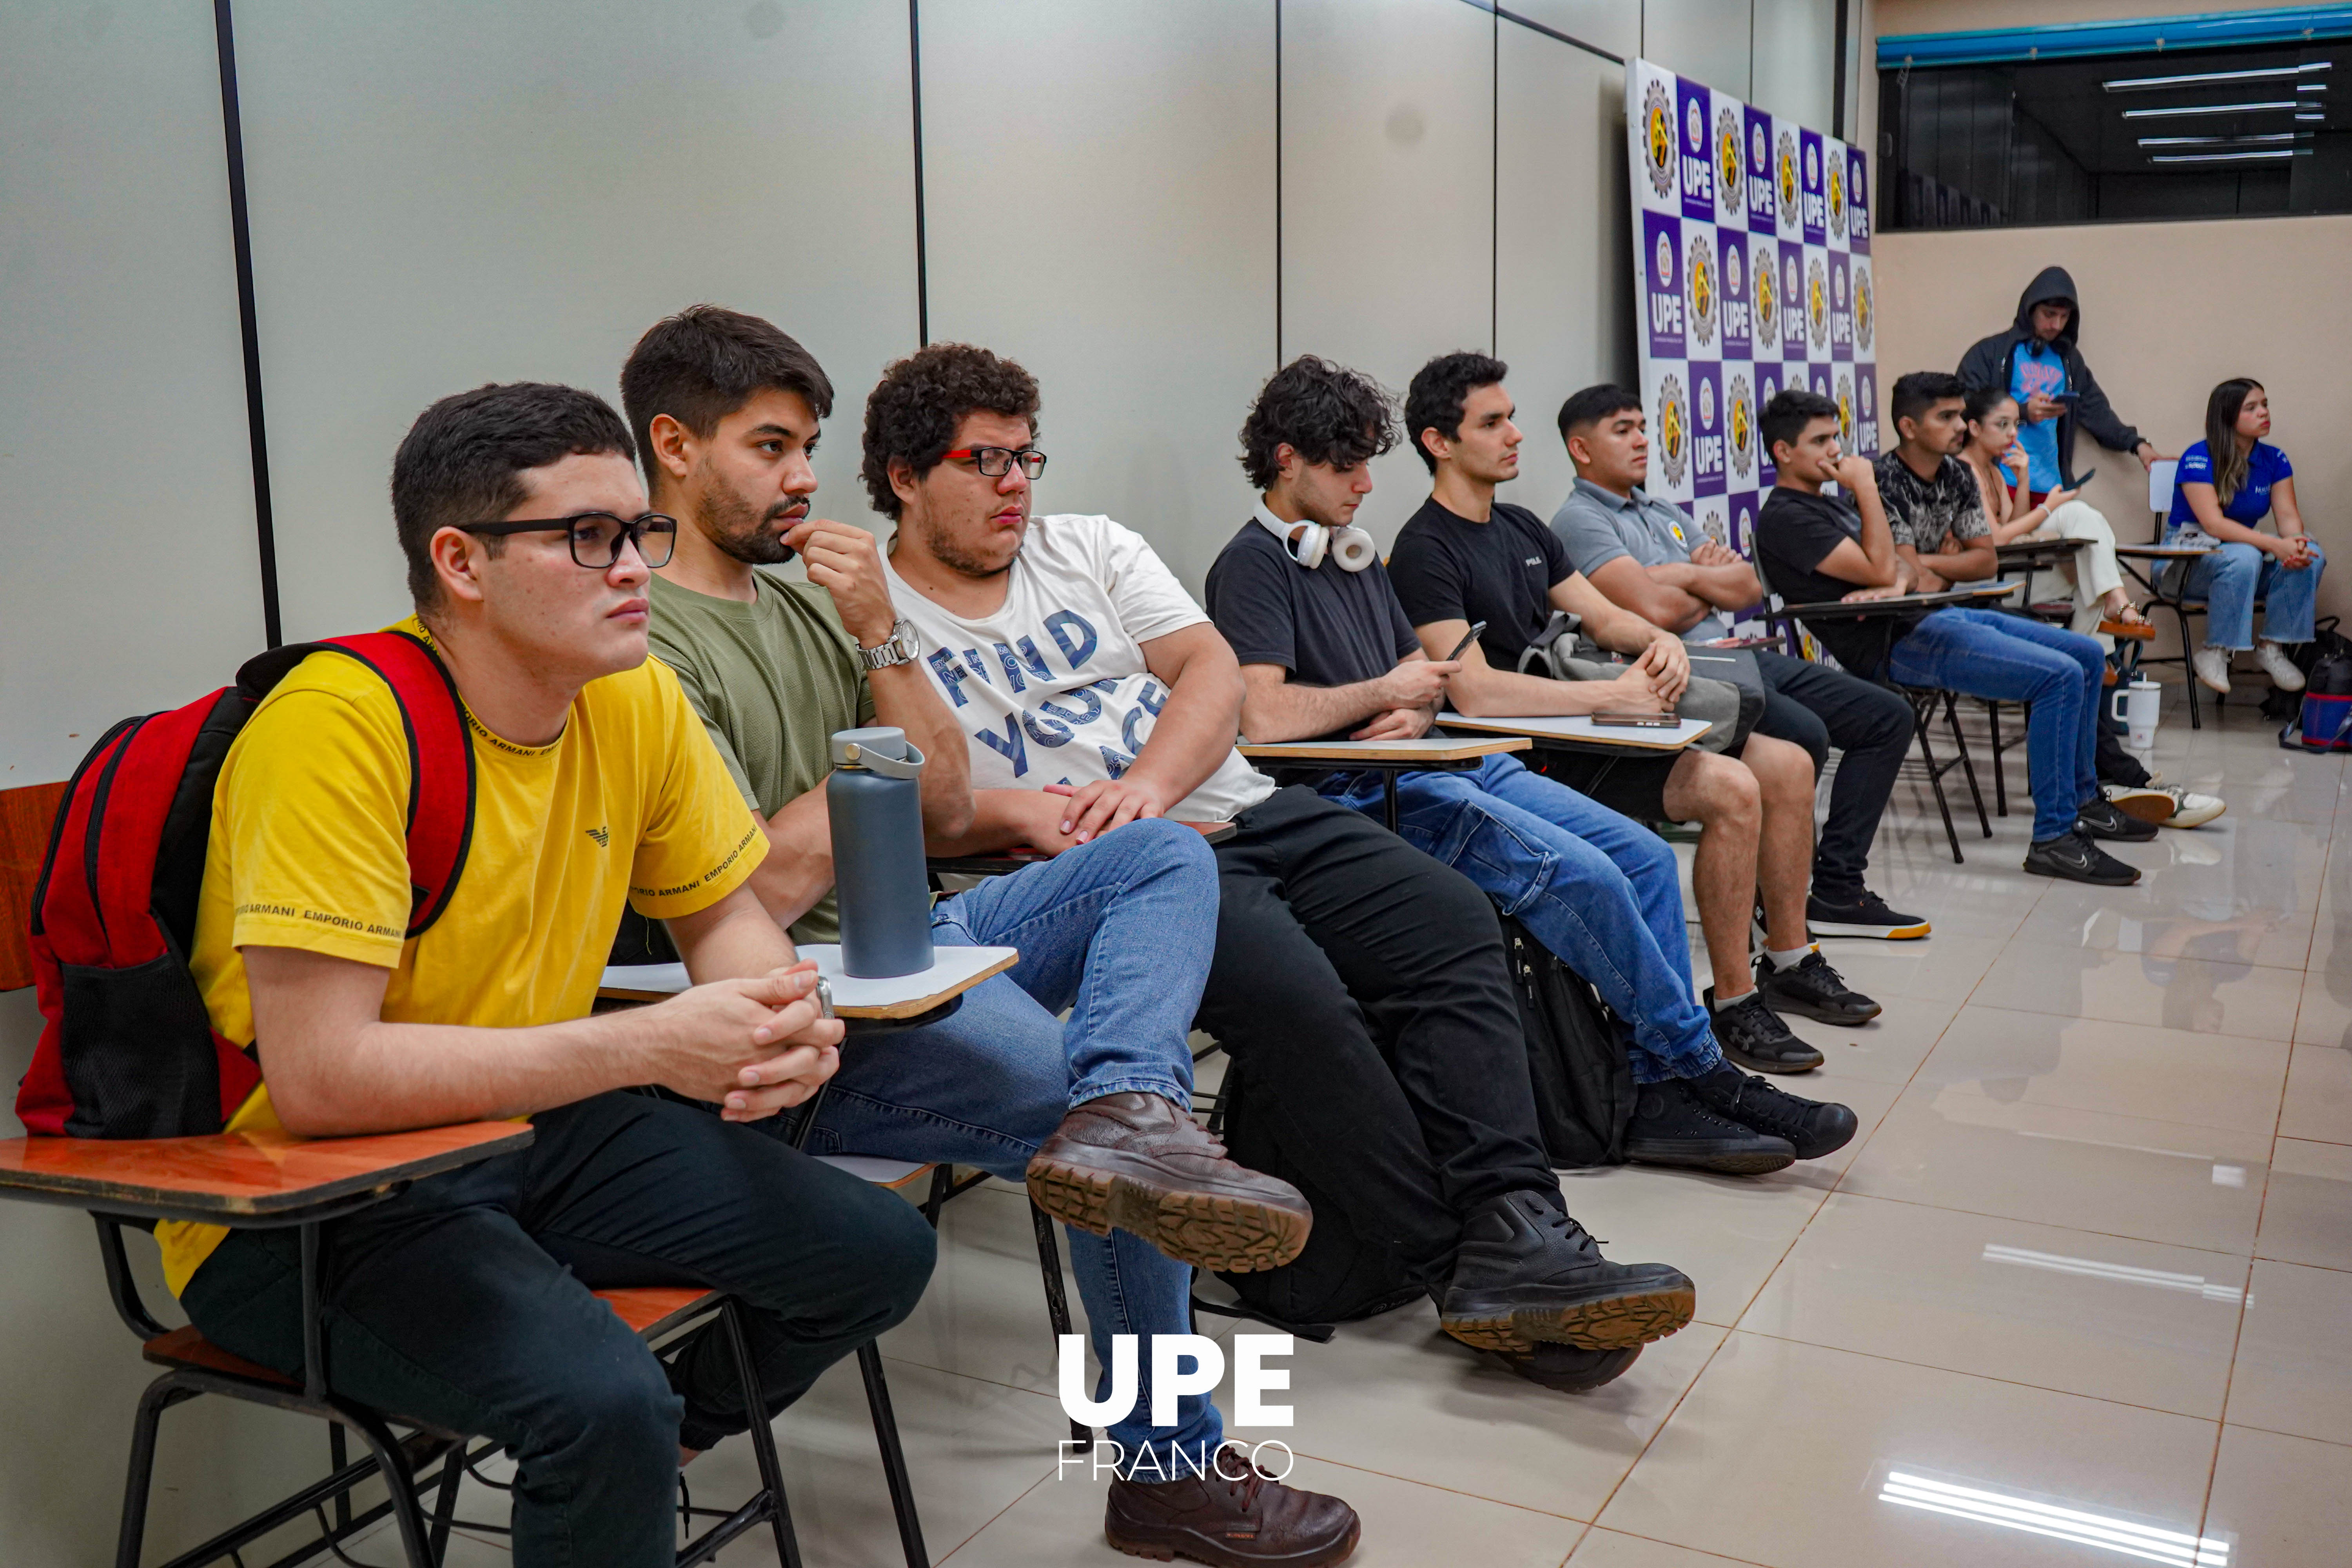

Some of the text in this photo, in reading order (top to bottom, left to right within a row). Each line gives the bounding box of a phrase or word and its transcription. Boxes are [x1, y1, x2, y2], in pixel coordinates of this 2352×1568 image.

[1682, 154, 1711, 200] UPE
[1749, 175, 1773, 214] UPE
[1804, 191, 1824, 228] UPE
[1850, 205, 1868, 238] UPE
[1651, 292, 1682, 334] UPE
[1723, 300, 1749, 338] UPE
[1784, 306, 1804, 341] UPE
[1832, 311, 1851, 343] UPE
[1695, 435, 1723, 475] UPE
[1859, 421, 1878, 452] UPE
[490, 739, 535, 756] ARMANI
[659, 880, 700, 897] ARMANI
[704, 850, 738, 882] EMPORIO
[739, 824, 757, 852] ARMANI
[249, 904, 295, 917] ARMANI
[304, 910, 363, 931] EMPORIO
